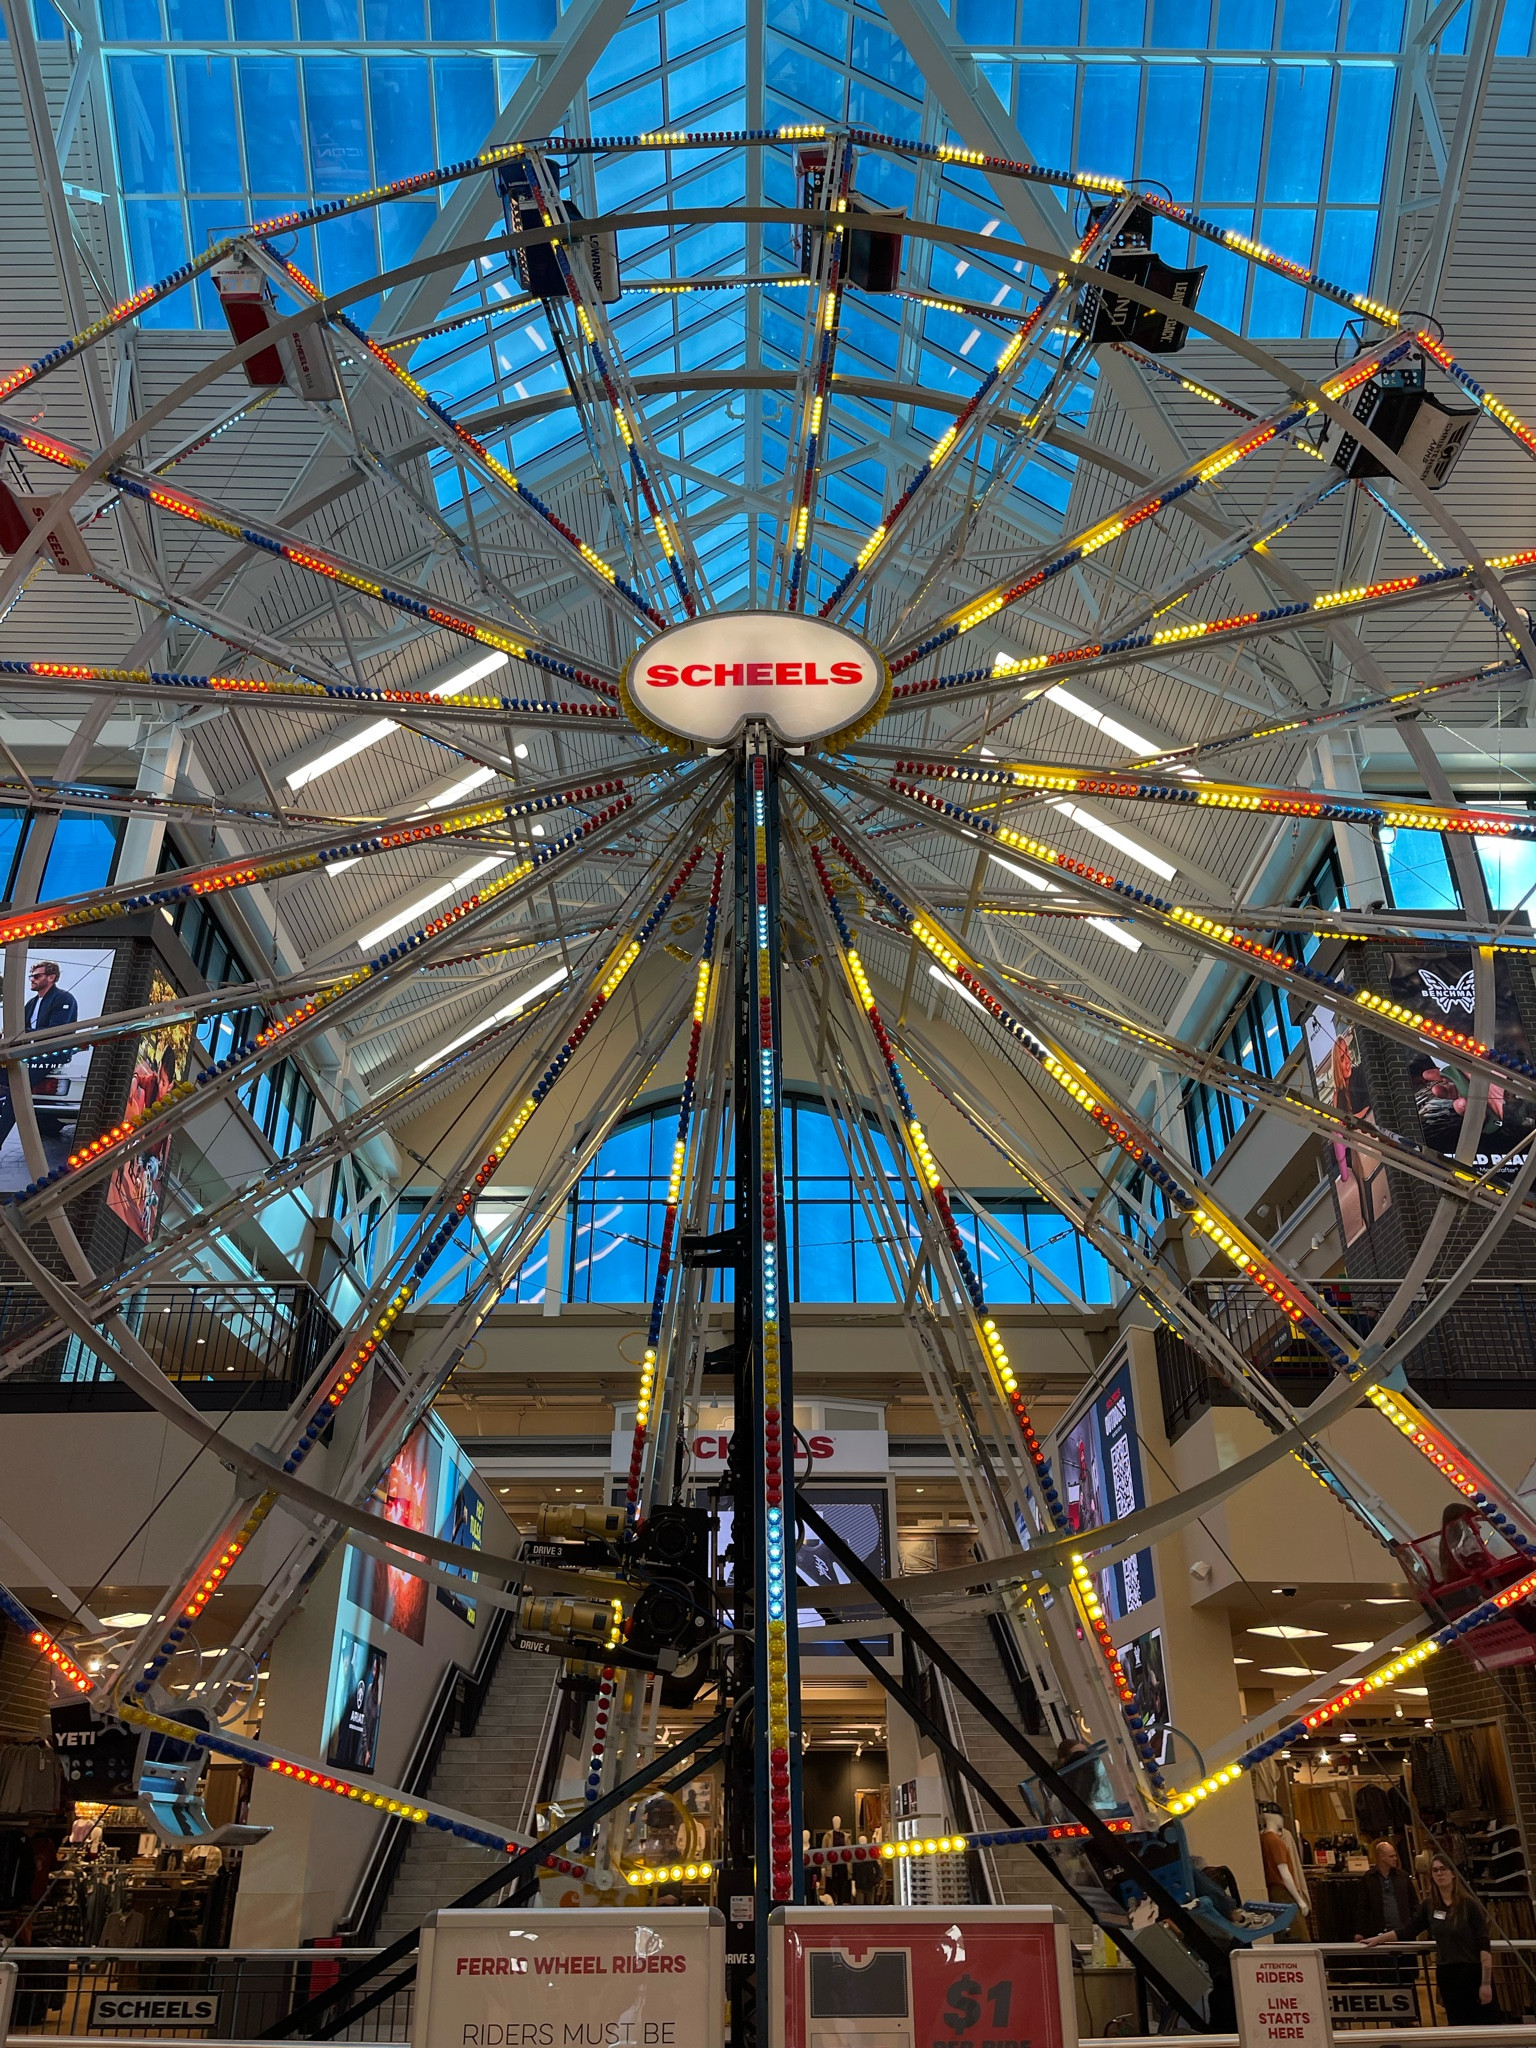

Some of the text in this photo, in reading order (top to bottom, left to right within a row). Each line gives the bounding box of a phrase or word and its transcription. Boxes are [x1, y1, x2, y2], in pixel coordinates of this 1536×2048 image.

[589, 235, 603, 292] LOWRANCE
[1160, 315, 1177, 343] EGACY.
[292, 332, 310, 373] SCHEELS
[1422, 439, 1437, 464] ARMS
[32, 507, 70, 567] SEELS
[645, 661, 863, 688] SCHEELS
[1421, 989, 1475, 997] BENCHMA
[533, 1545, 563, 1556] DRIVE 3
[520, 1640, 551, 1653] DRIVE 4
[55, 1731, 95, 1747] YETI
[533, 1956, 608, 1975] WHEEL
[612, 1954, 687, 1975] RIDERS
[749, 1953, 755, 1964] 3
[1259, 1962, 1298, 1970] ATTENTION
[1255, 1971, 1304, 1984] RIDERS
[98, 2001, 213, 2019] SCHEELS
[943, 1973, 1013, 2036] $1
[1268, 1997, 1298, 2010] LINE
[1329, 1994, 1410, 2013] HEELS
[1258, 2012, 1311, 2025] STARTS
[462, 2021, 676, 2046] RIDERS MUST BE
[1268, 2027, 1305, 2040] HERE
